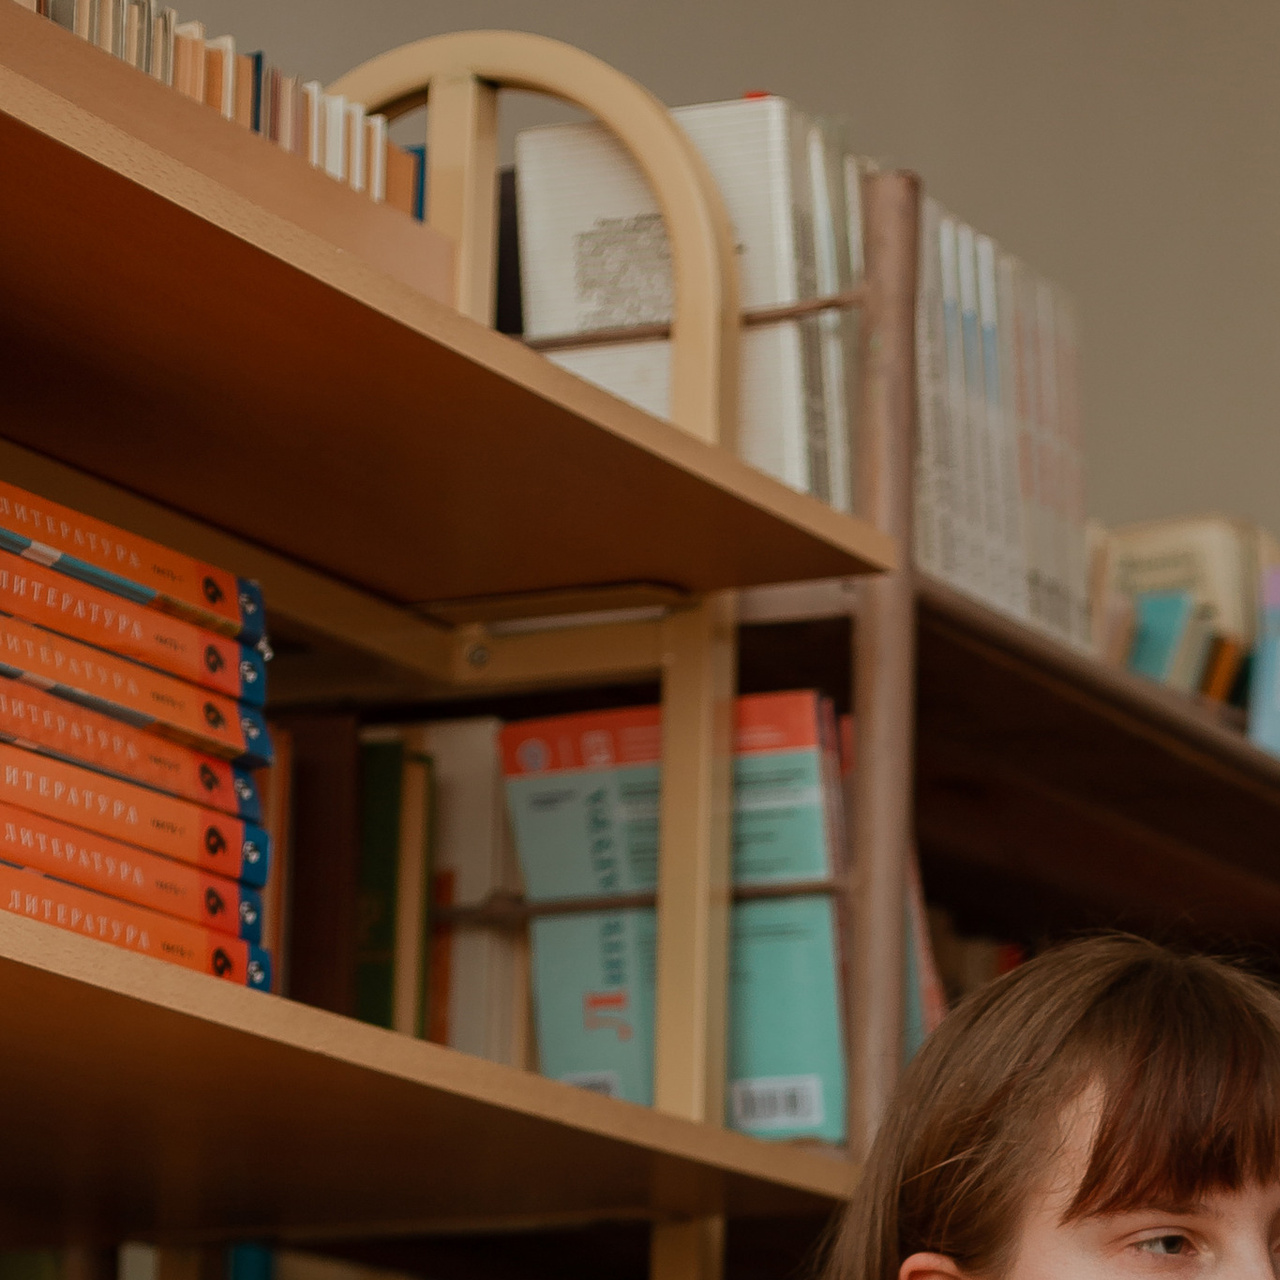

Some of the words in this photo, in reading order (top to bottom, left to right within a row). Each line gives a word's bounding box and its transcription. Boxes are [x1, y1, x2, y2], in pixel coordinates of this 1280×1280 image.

[5, 632, 139, 696] ИТЕРАТУРА
[4, 822, 144, 887] ЛИТЕРАТУРА
[9, 888, 150, 950] ЛИТЕРАТУРА
